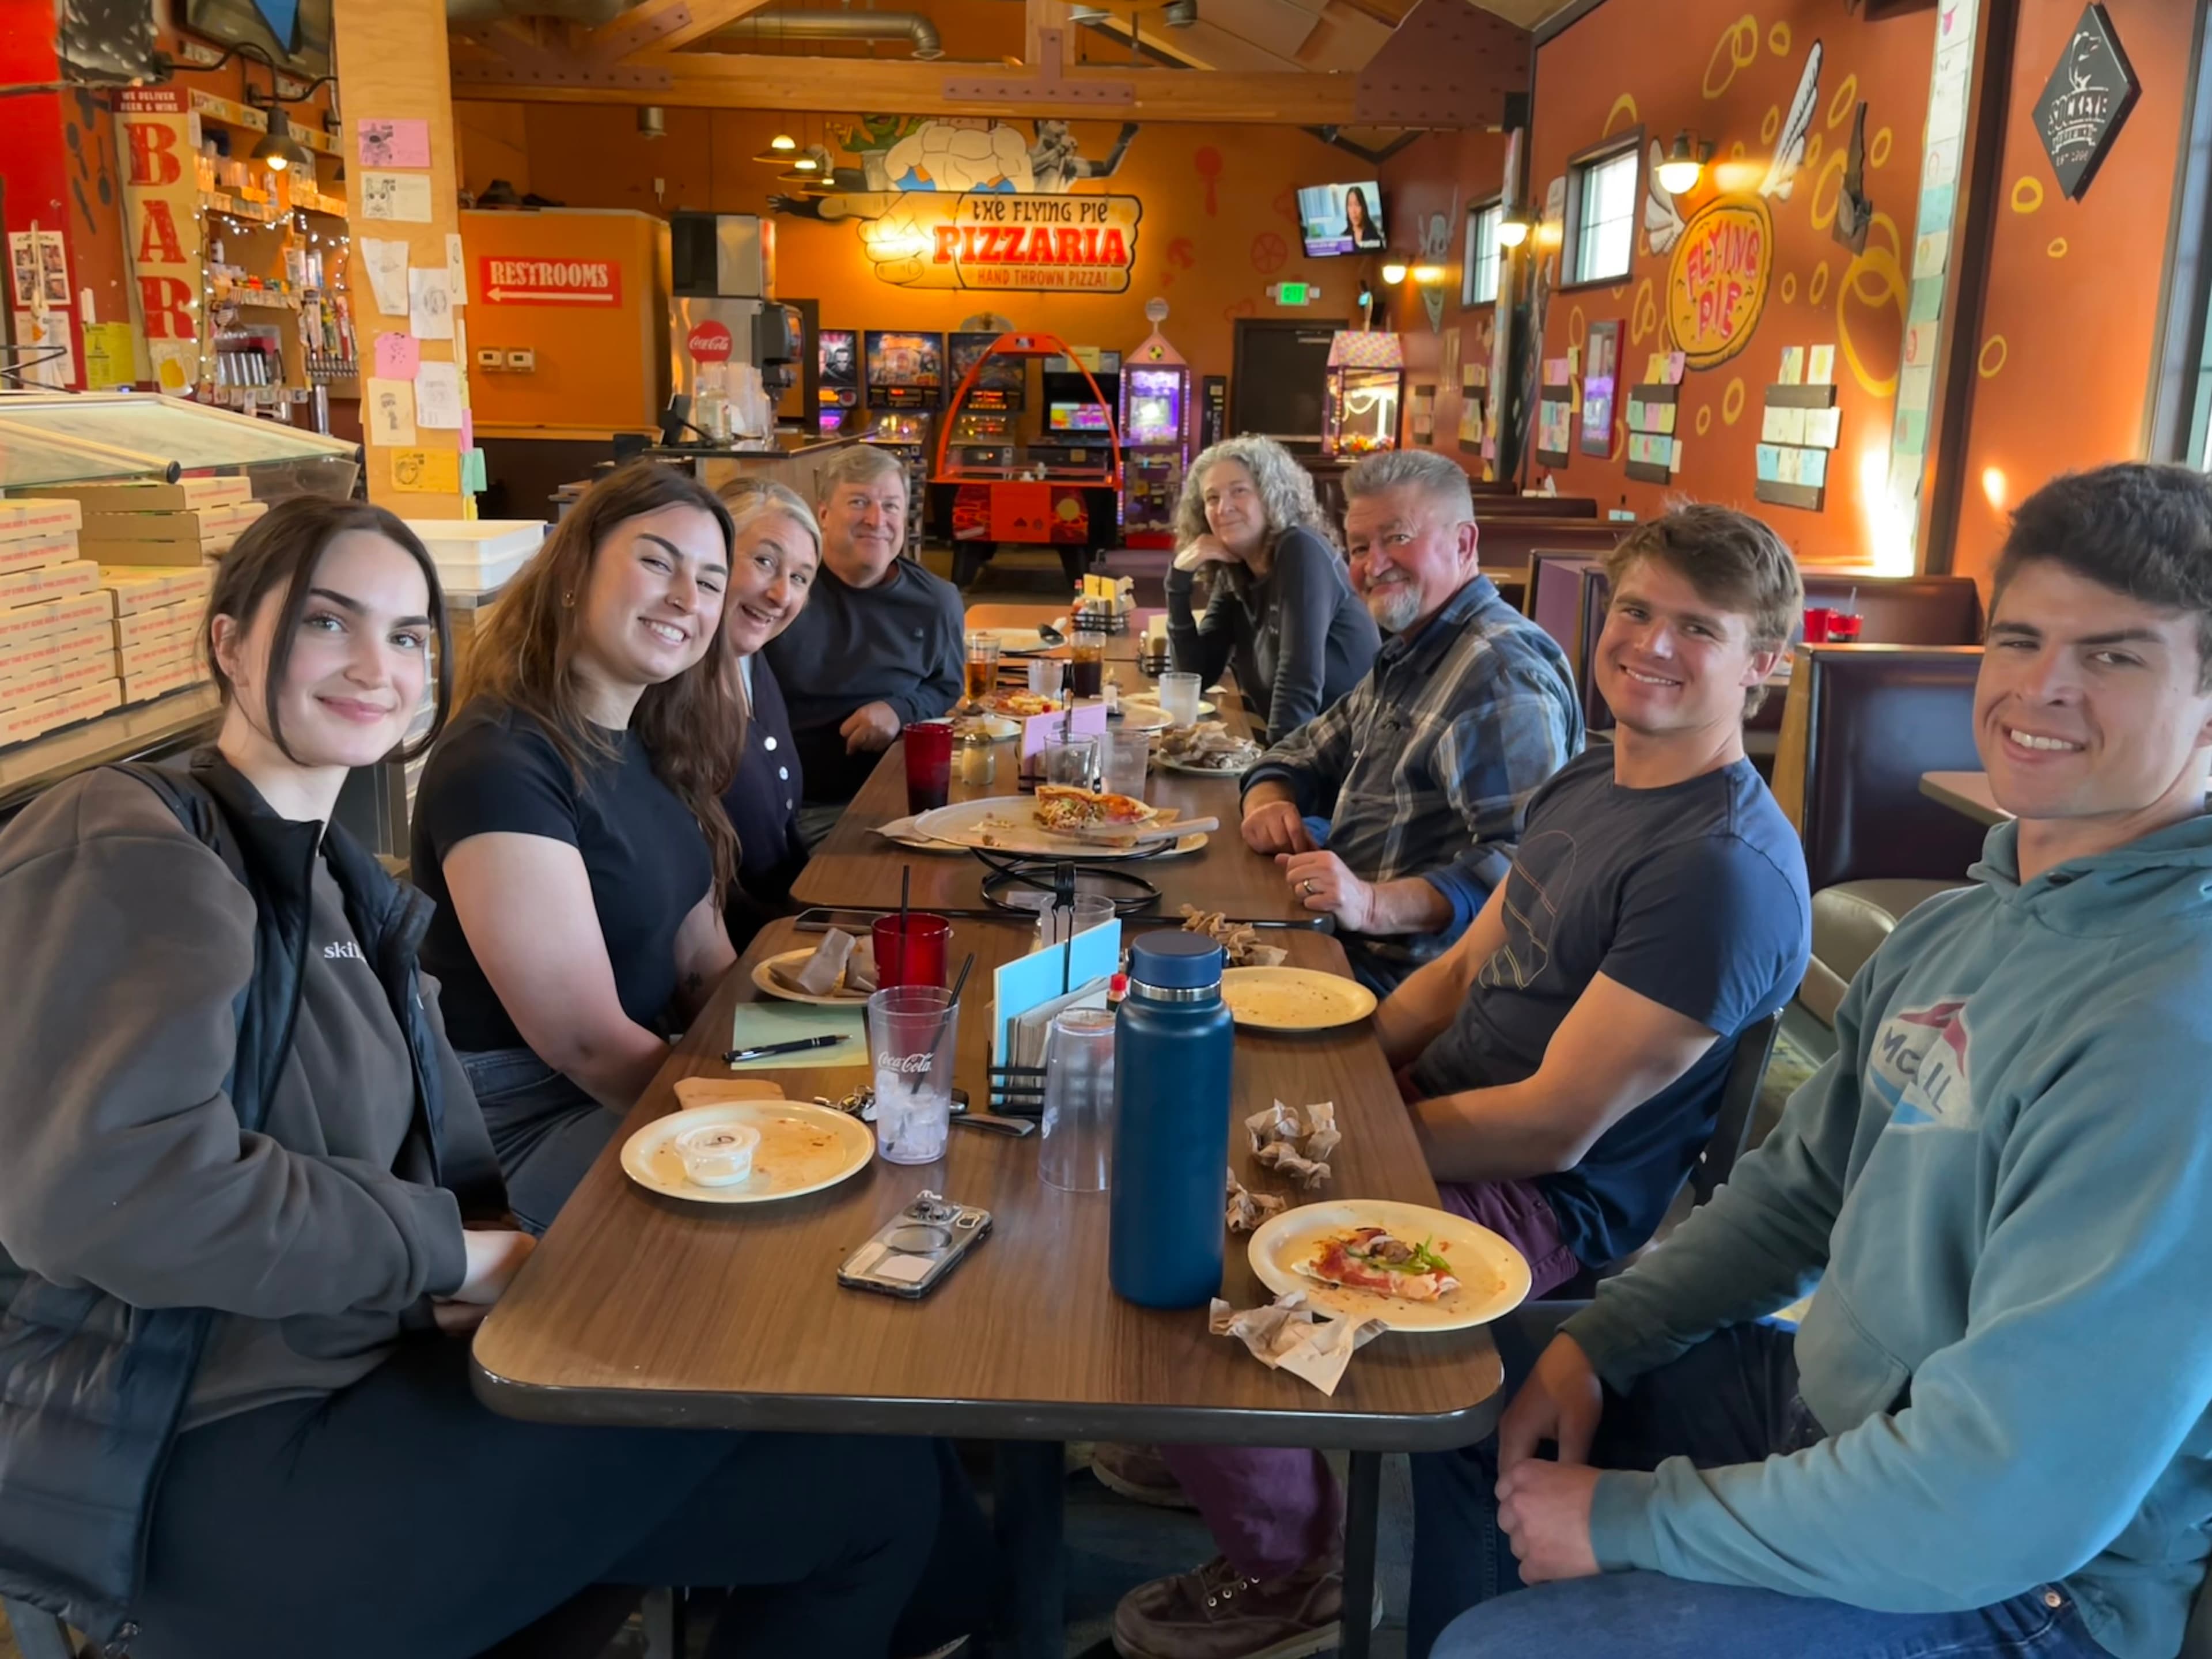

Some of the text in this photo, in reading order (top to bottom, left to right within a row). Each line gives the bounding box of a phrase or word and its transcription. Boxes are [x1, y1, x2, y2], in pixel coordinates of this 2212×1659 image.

[123, 122, 198, 340] BAR
[933, 225, 1128, 266] PIZZARIA
[490, 260, 609, 288] RESTROOMS
[1687, 218, 1760, 303] FLYING
[978, 270, 1011, 286] HAND
[1014, 270, 1065, 287] THROWN
[1698, 279, 1743, 342] PIE
[689, 335, 729, 351] Coca-Cola
[323, 941, 368, 964] skil
[878, 1050, 934, 1073] Coca-Cola
